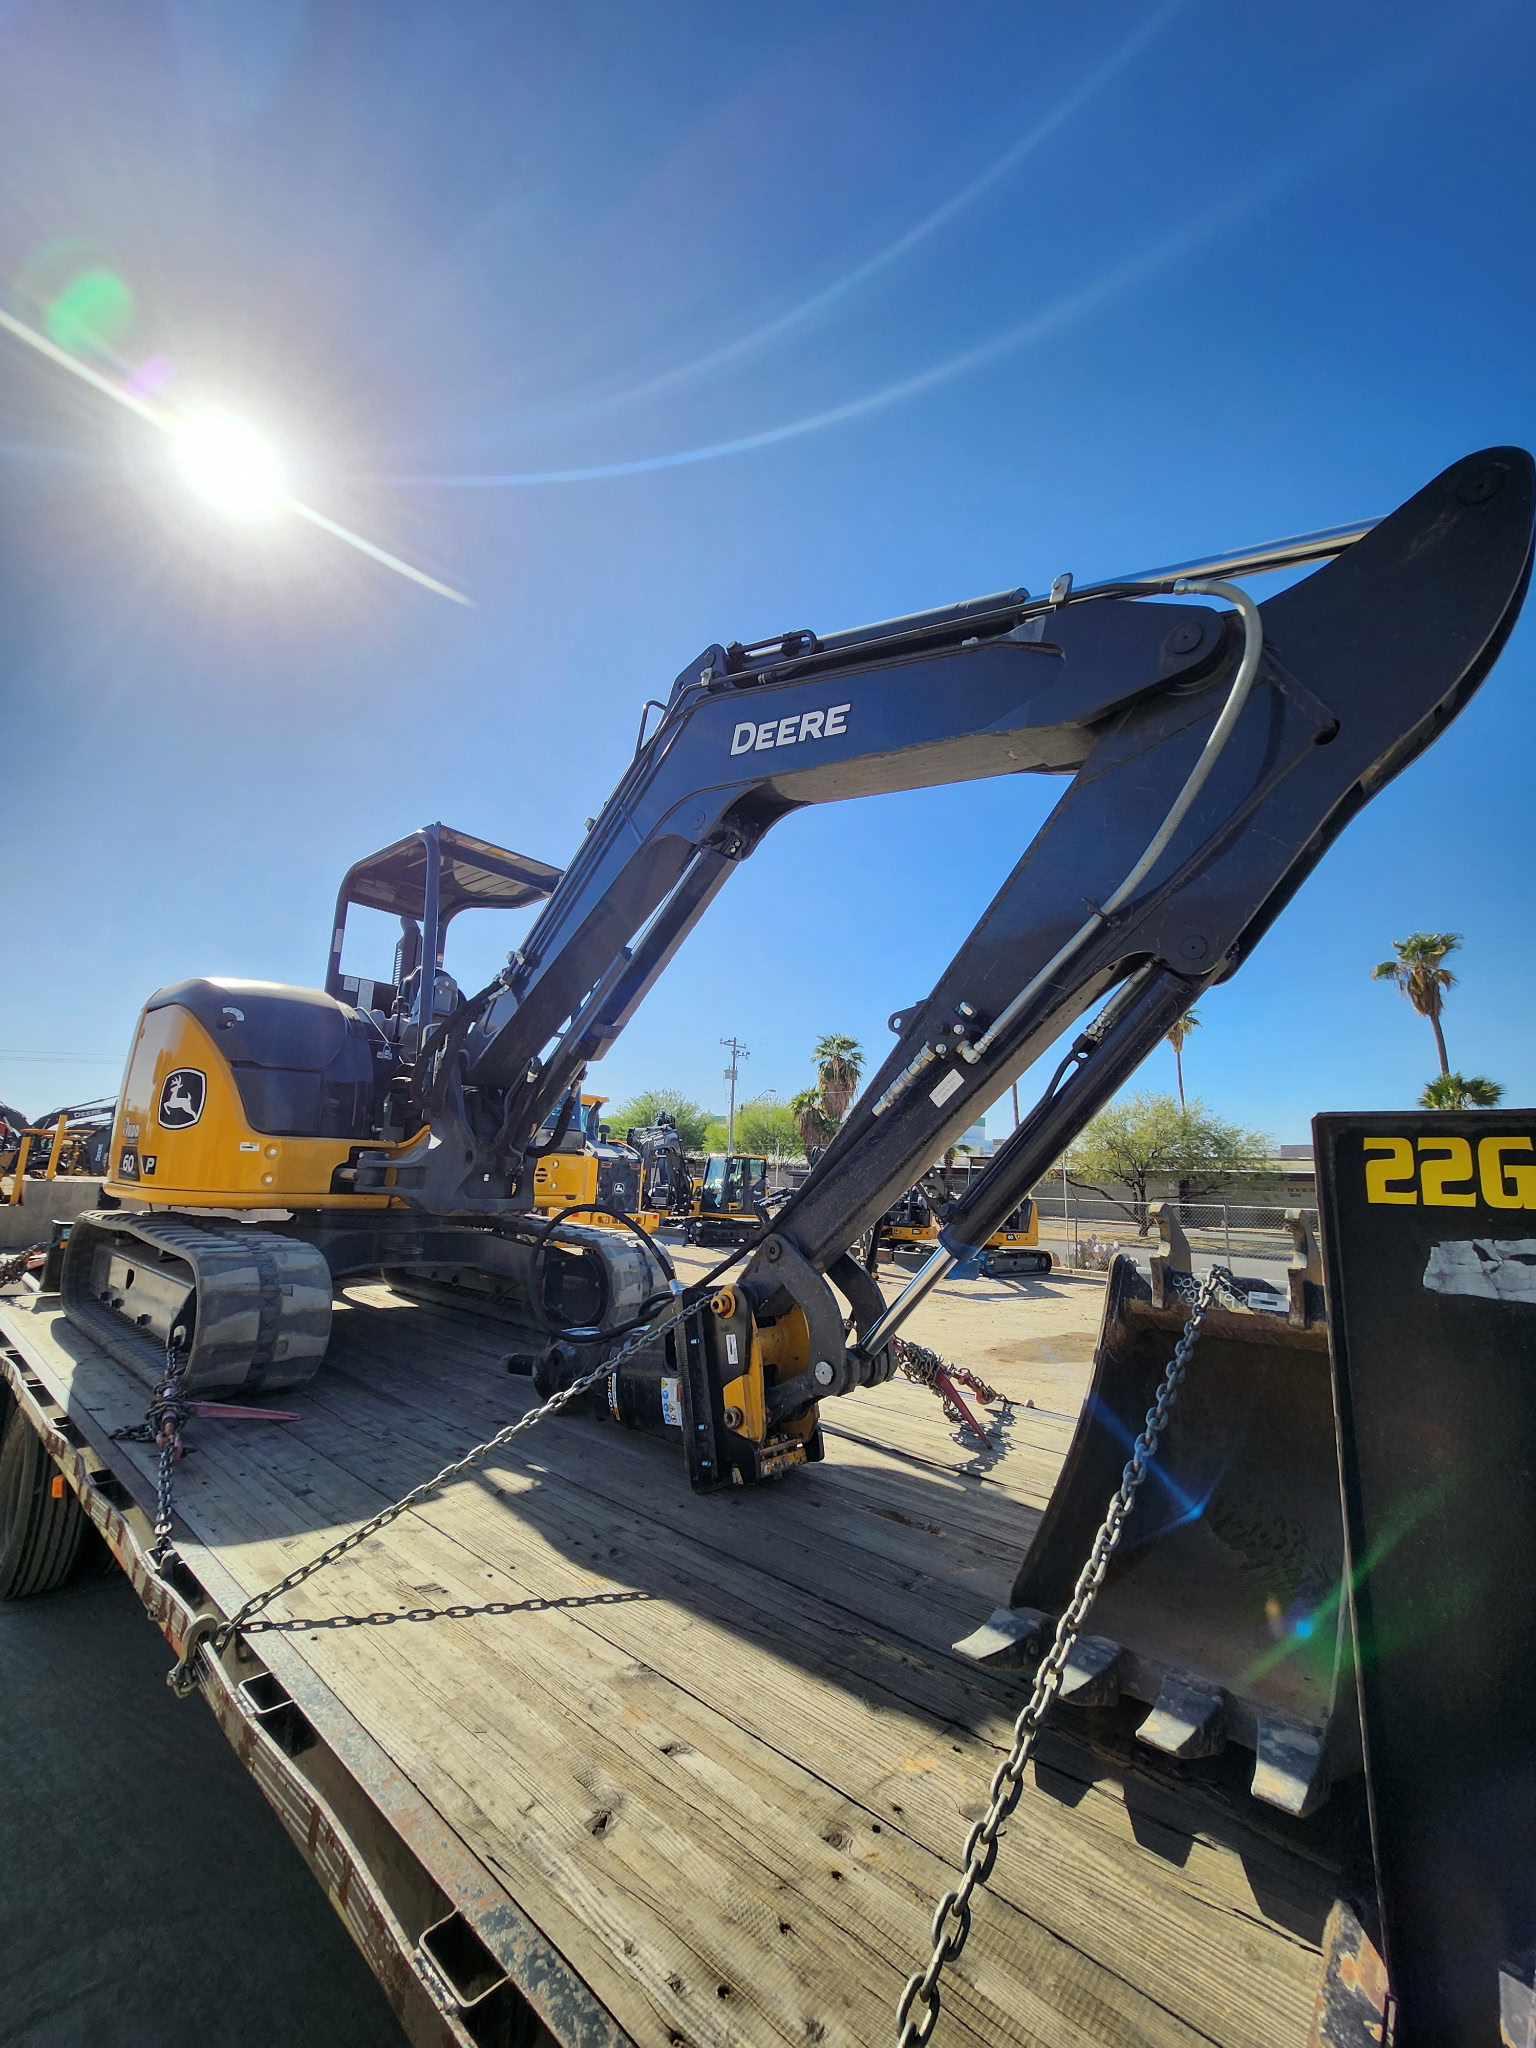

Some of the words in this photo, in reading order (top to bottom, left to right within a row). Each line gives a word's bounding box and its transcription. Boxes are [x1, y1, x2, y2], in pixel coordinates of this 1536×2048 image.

[729, 703, 851, 756] DEERE
[74, 1109, 102, 1118] DEERE
[122, 1154, 134, 1172] 60
[145, 1157, 154, 1172] P
[1363, 1136, 1536, 1210] 22G
